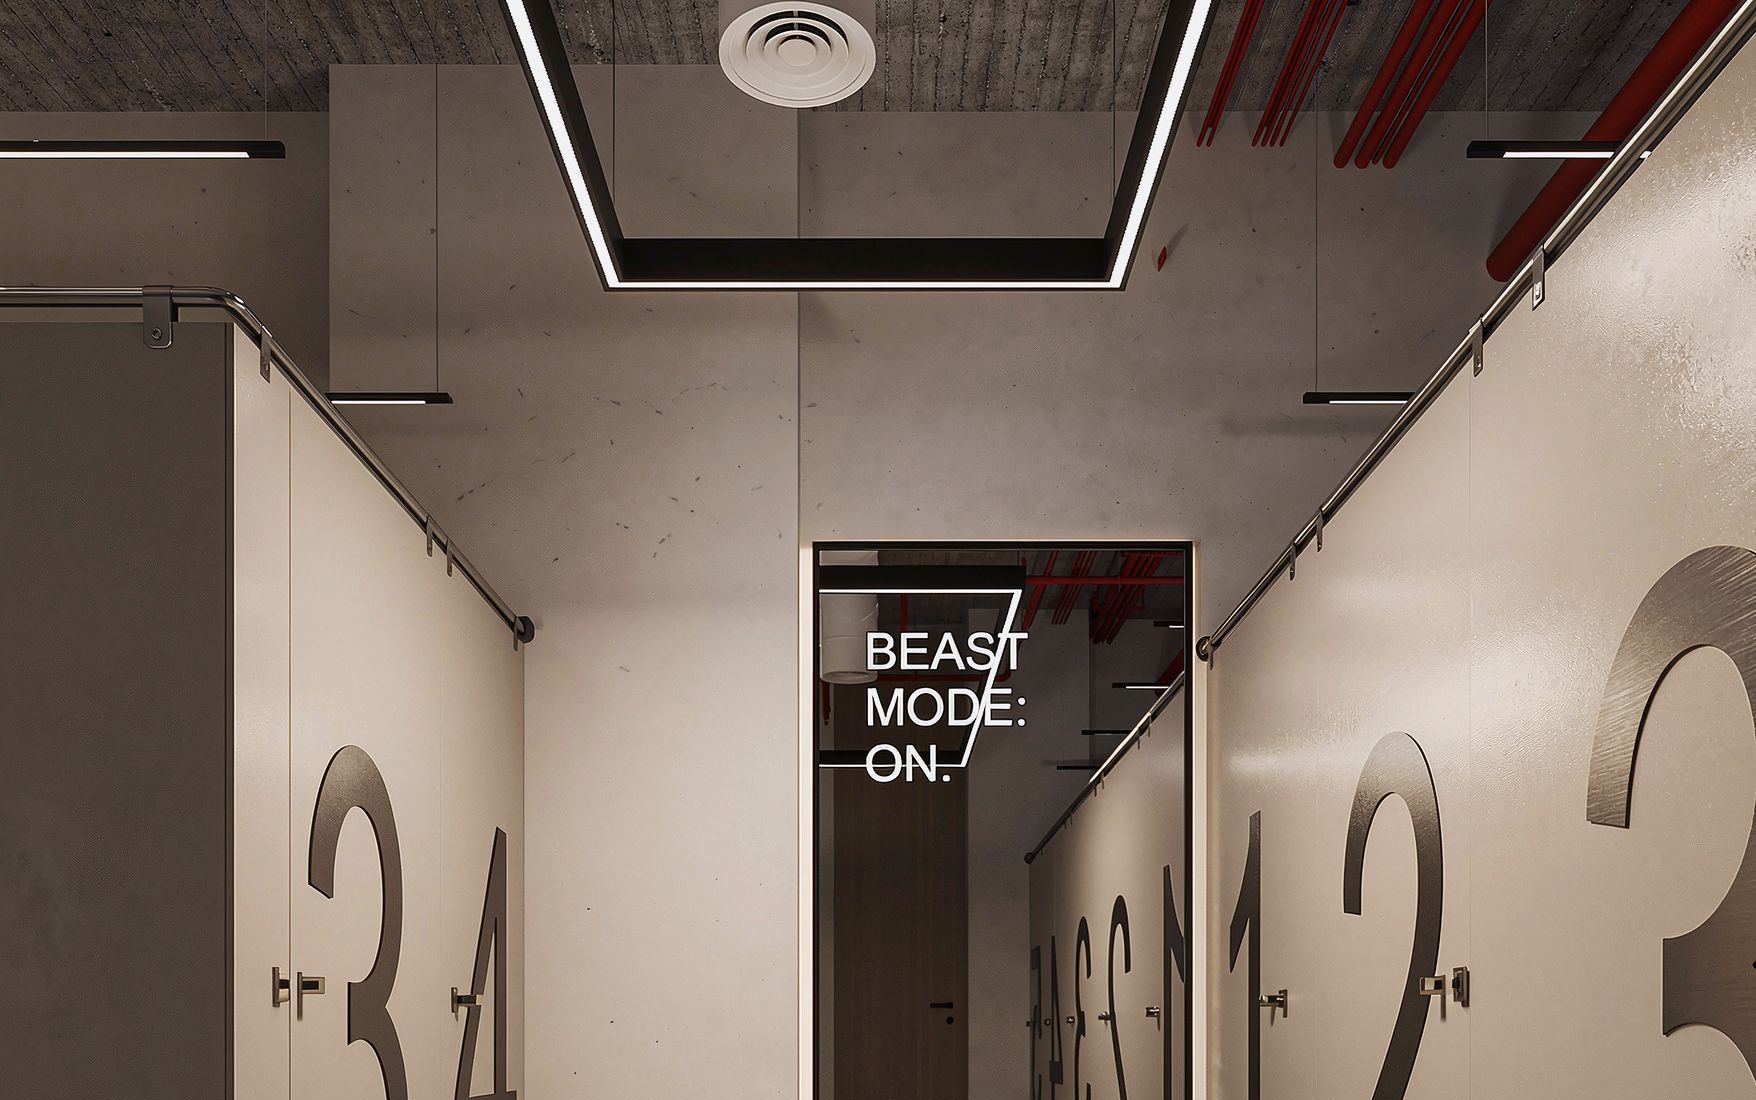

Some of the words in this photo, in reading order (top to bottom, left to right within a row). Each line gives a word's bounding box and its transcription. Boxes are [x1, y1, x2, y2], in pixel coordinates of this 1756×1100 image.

[867, 632, 1028, 671] BEAST
[867, 687, 1027, 727] MODE:
[866, 744, 951, 782] ON.
